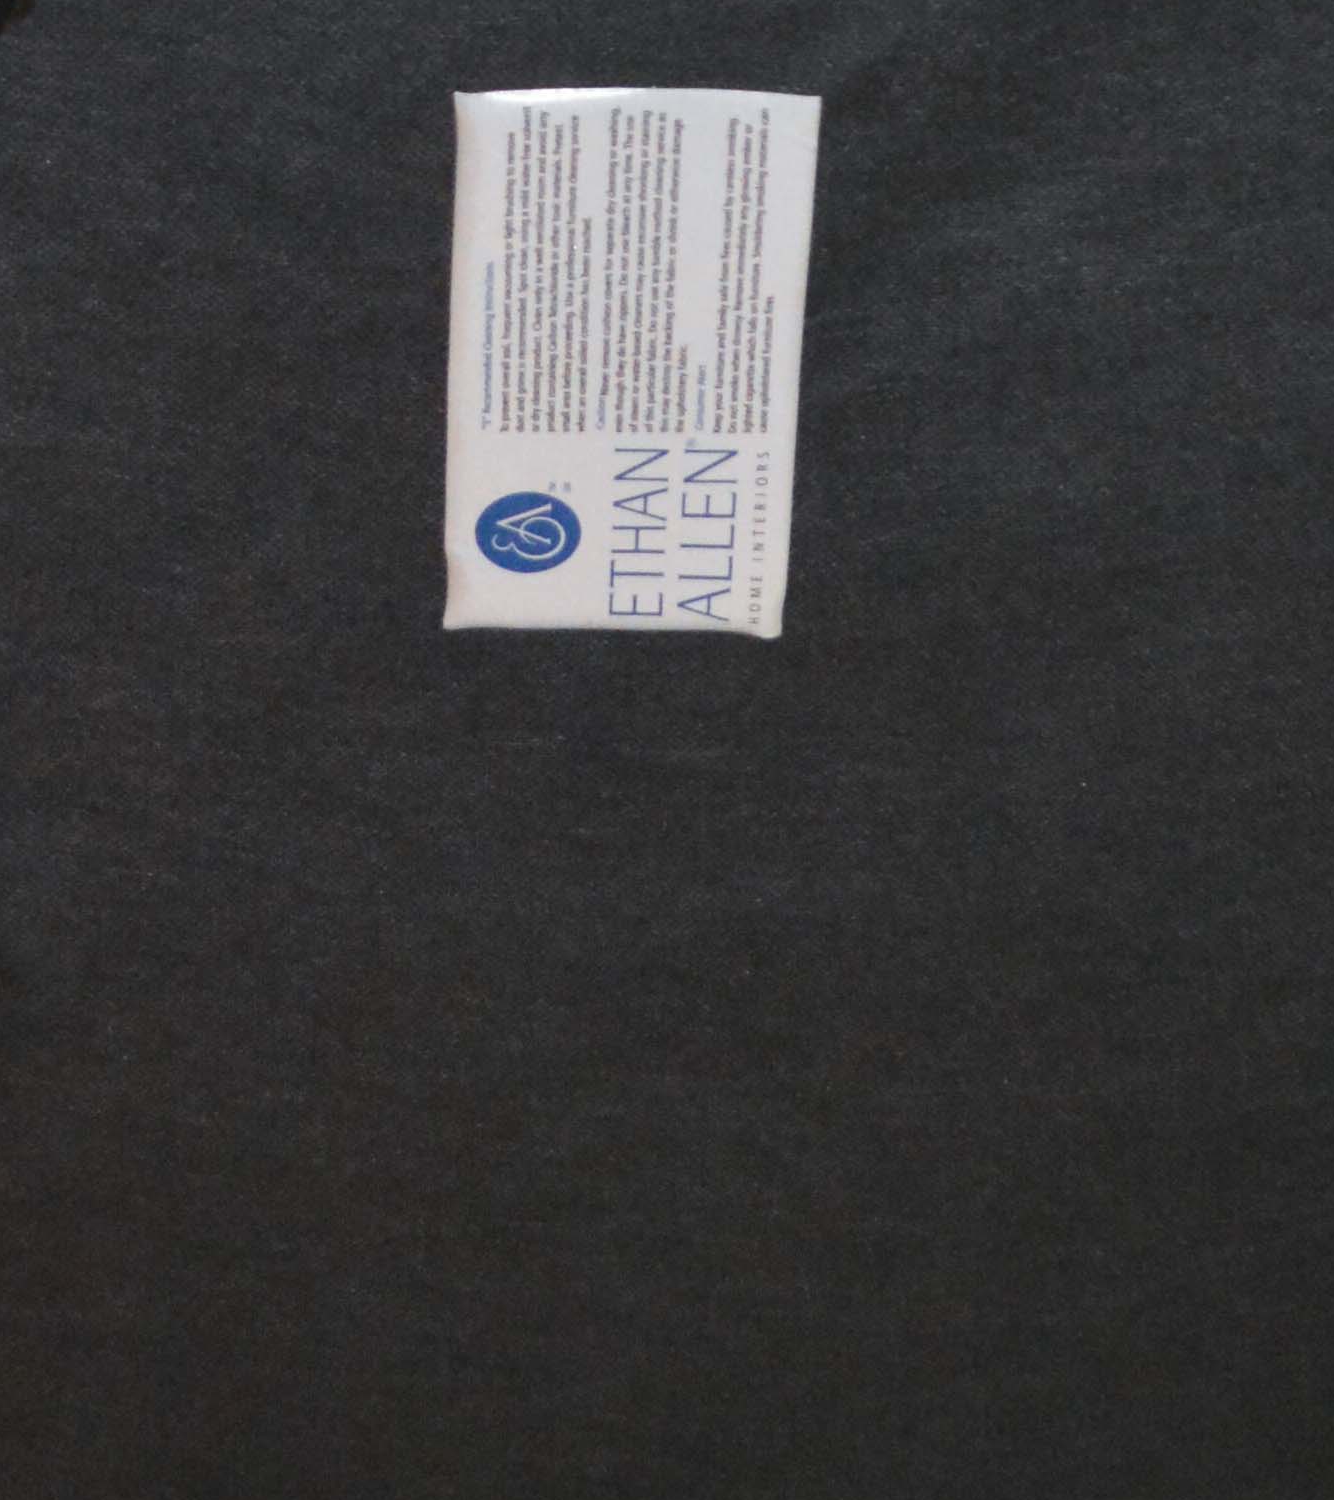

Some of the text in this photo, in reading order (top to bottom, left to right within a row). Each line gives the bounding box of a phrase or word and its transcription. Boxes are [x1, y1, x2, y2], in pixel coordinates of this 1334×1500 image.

[608, 448, 670, 618] ETHAN
[676, 449, 739, 623] ALLEN
[752, 451, 770, 561] INTERIORS
[747, 575, 763, 624] HOME
